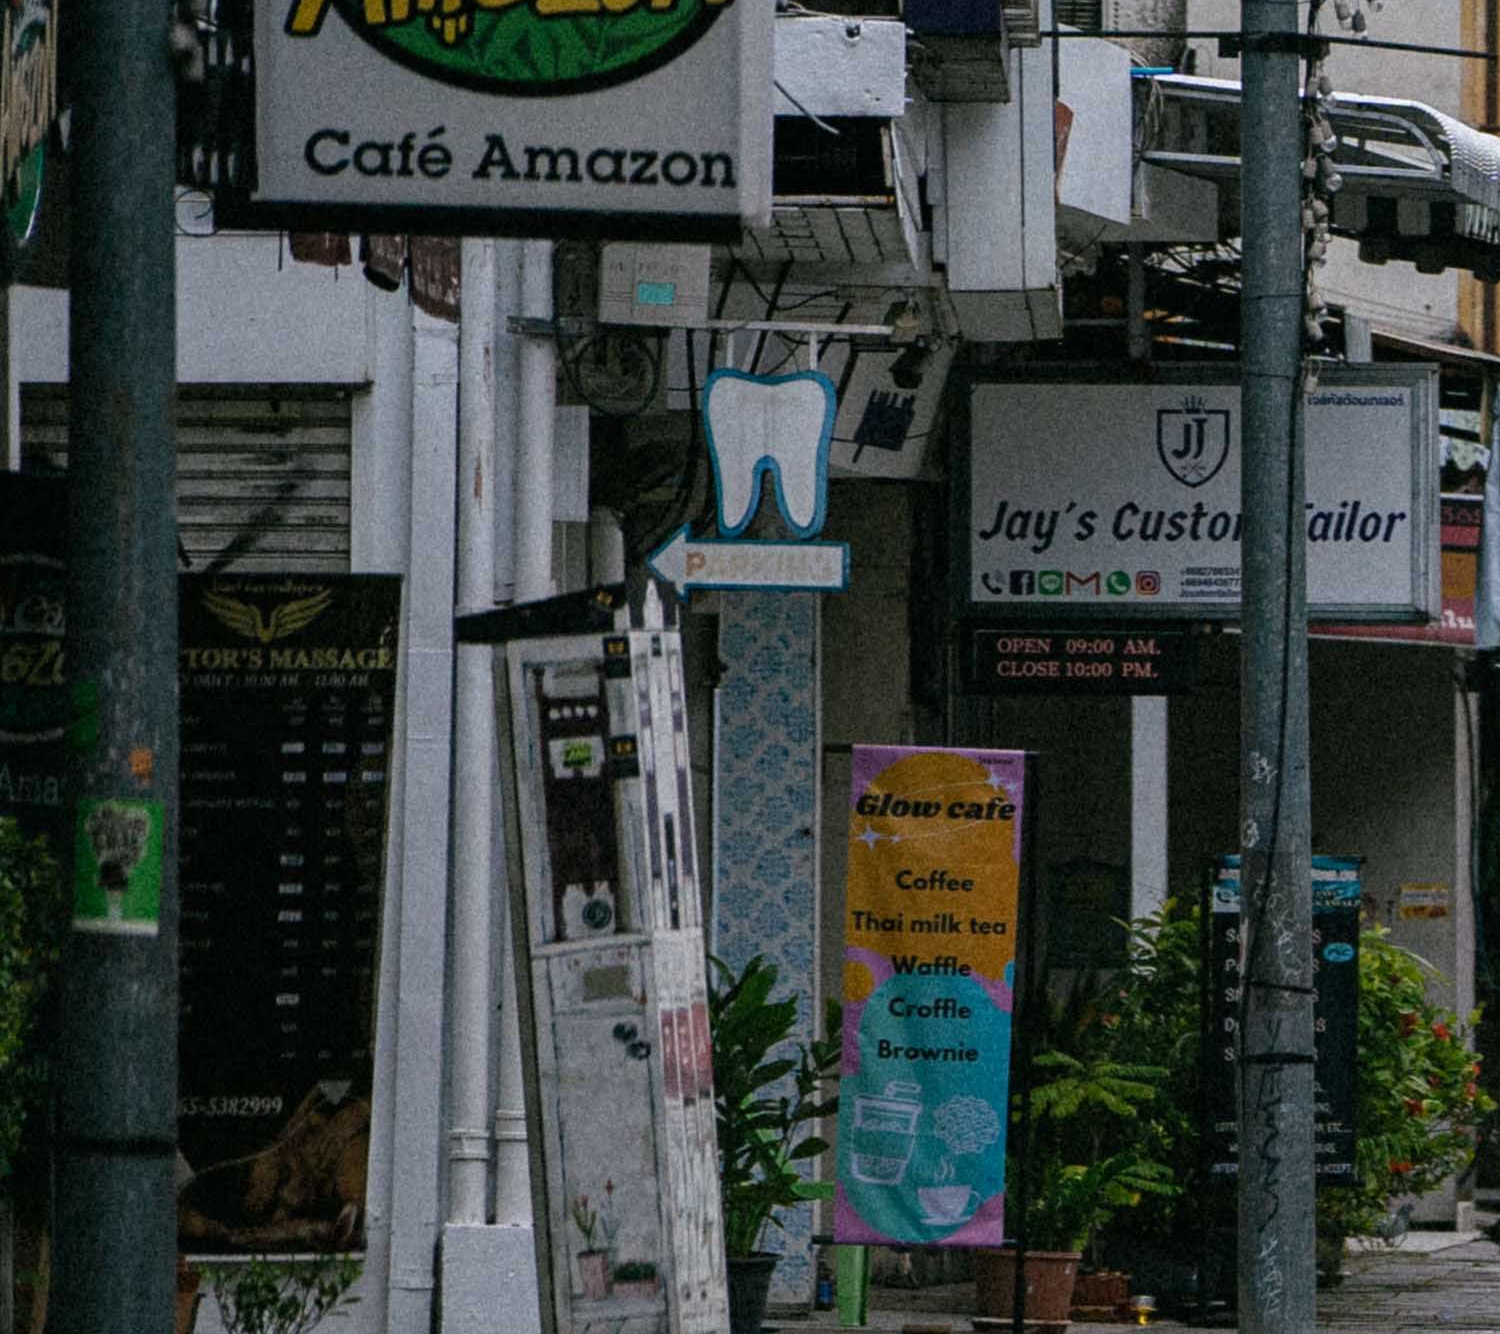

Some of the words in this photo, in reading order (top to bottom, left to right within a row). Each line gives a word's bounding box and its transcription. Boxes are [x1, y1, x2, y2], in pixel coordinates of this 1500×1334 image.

[304, 126, 454, 182] Café
[471, 132, 738, 190] Amazon
[1111, 500, 1243, 543] Custo
[1304, 500, 1407, 544] ailor
[996, 637, 1053, 656] OPEN
[1065, 638, 1116, 656] 09:00
[1122, 638, 1163, 656] AM.
[996, 660, 1061, 679] CLOSE
[1065, 661, 1114, 679] 10:00
[1120, 662, 1161, 679] PM.
[855, 792, 943, 819] Glow
[895, 869, 975, 893] Coffee
[852, 910, 904, 934] Thai
[910, 913, 962, 935] milk
[969, 918, 1009, 936] tea
[891, 954, 973, 978] Waffle
[888, 996, 973, 1021] Croffle
[877, 1038, 980, 1063] Brownie
